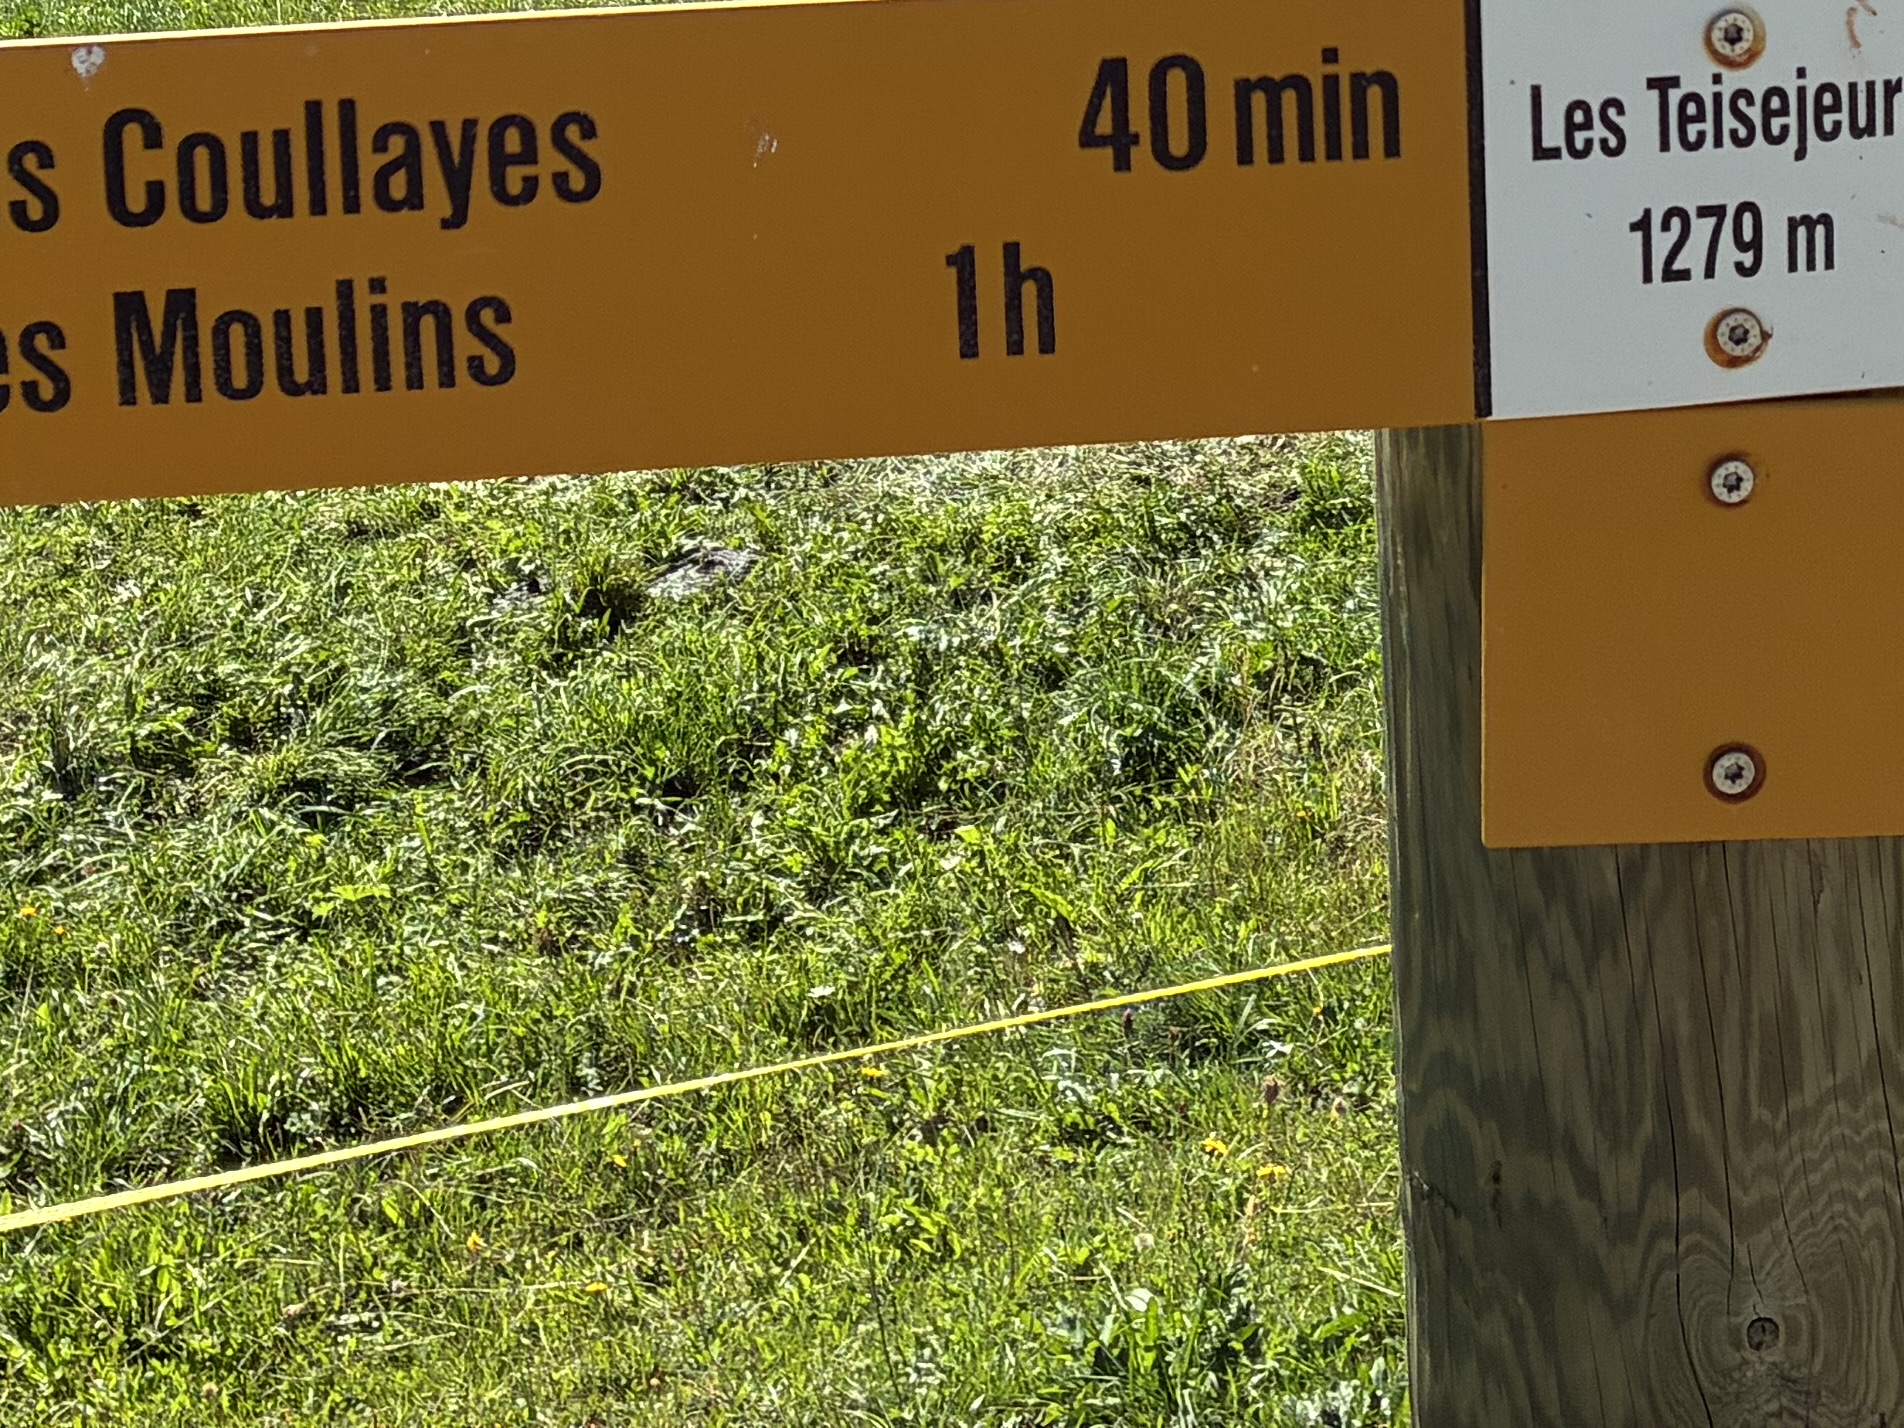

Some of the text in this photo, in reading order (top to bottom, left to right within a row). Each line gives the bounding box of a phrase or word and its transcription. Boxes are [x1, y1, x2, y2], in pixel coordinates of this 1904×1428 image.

[100, 96, 604, 233] Coullayes
[1529, 83, 1628, 163] Les
[1627, 199, 1836, 286] 1279 m
[110, 274, 518, 409] Moulins
